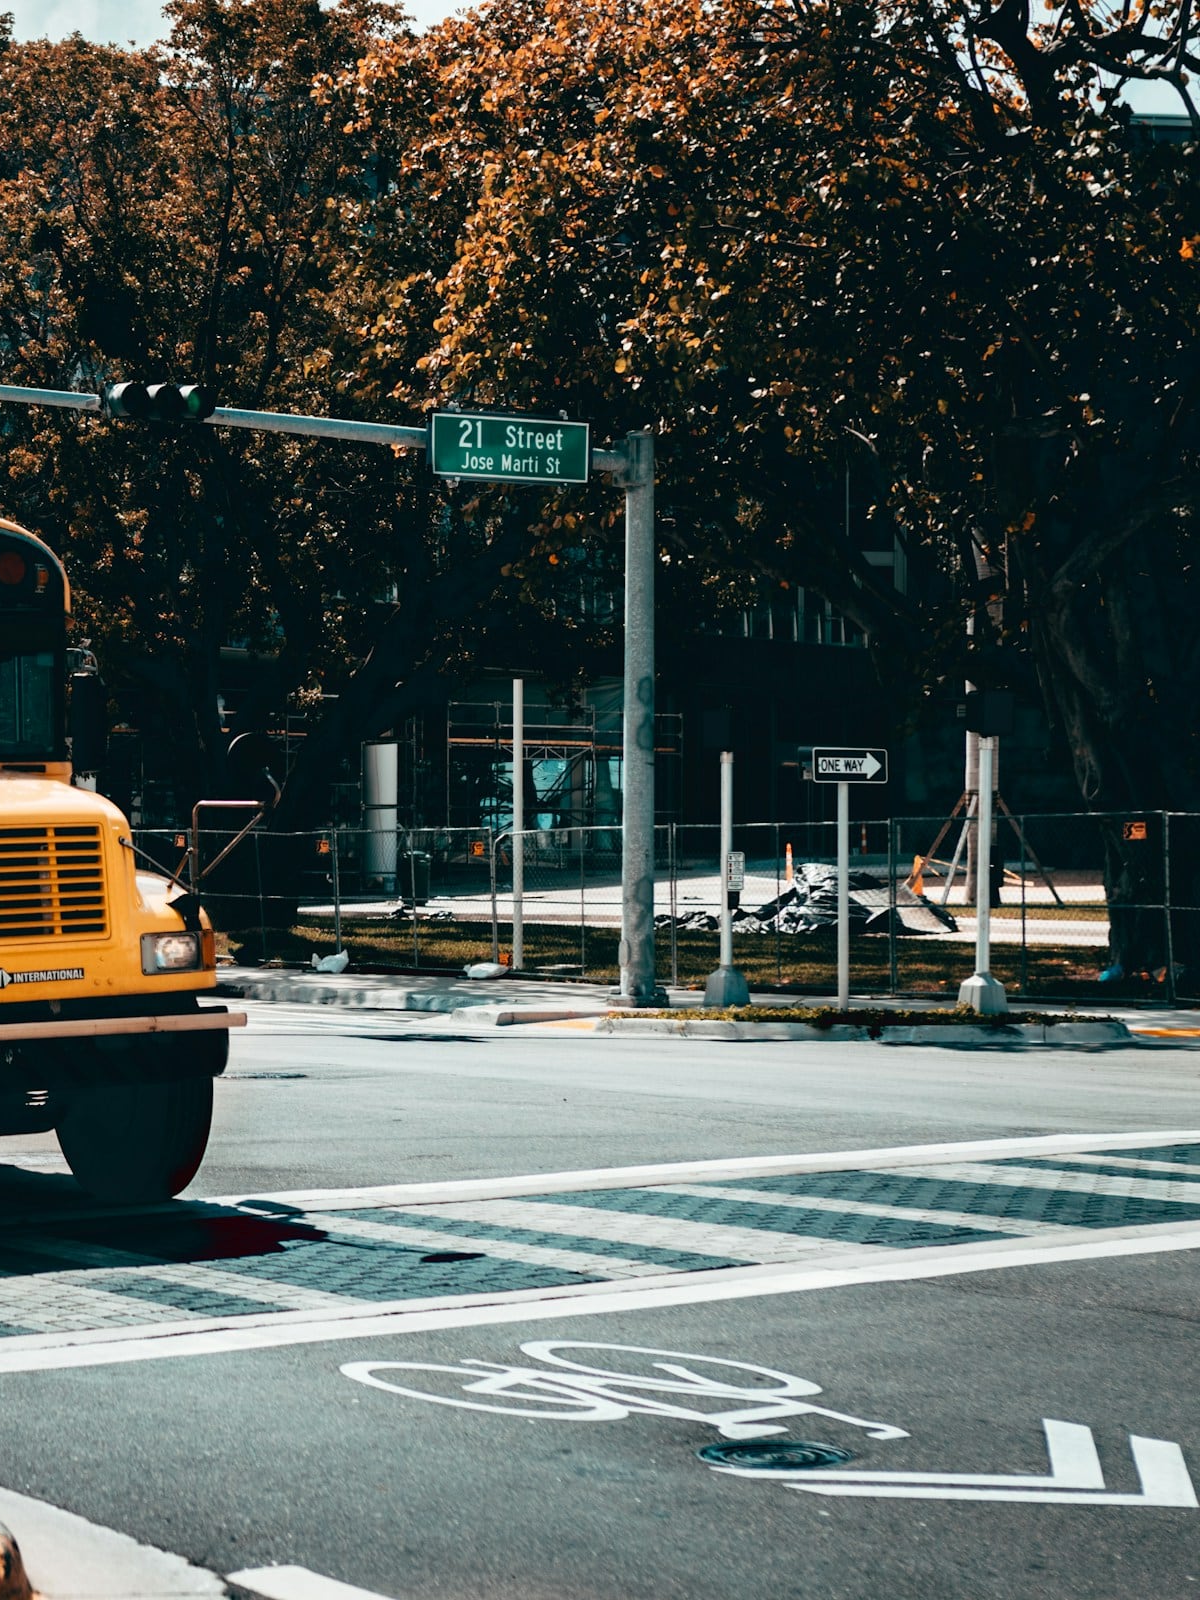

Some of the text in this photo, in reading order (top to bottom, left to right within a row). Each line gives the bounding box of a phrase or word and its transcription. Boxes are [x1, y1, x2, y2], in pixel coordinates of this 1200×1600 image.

[458, 419, 564, 451] 21 Street
[461, 451, 561, 475] Jose Marti St
[821, 759, 864, 772] ONE WAY
[13, 968, 84, 984] INTERNATIONAL
